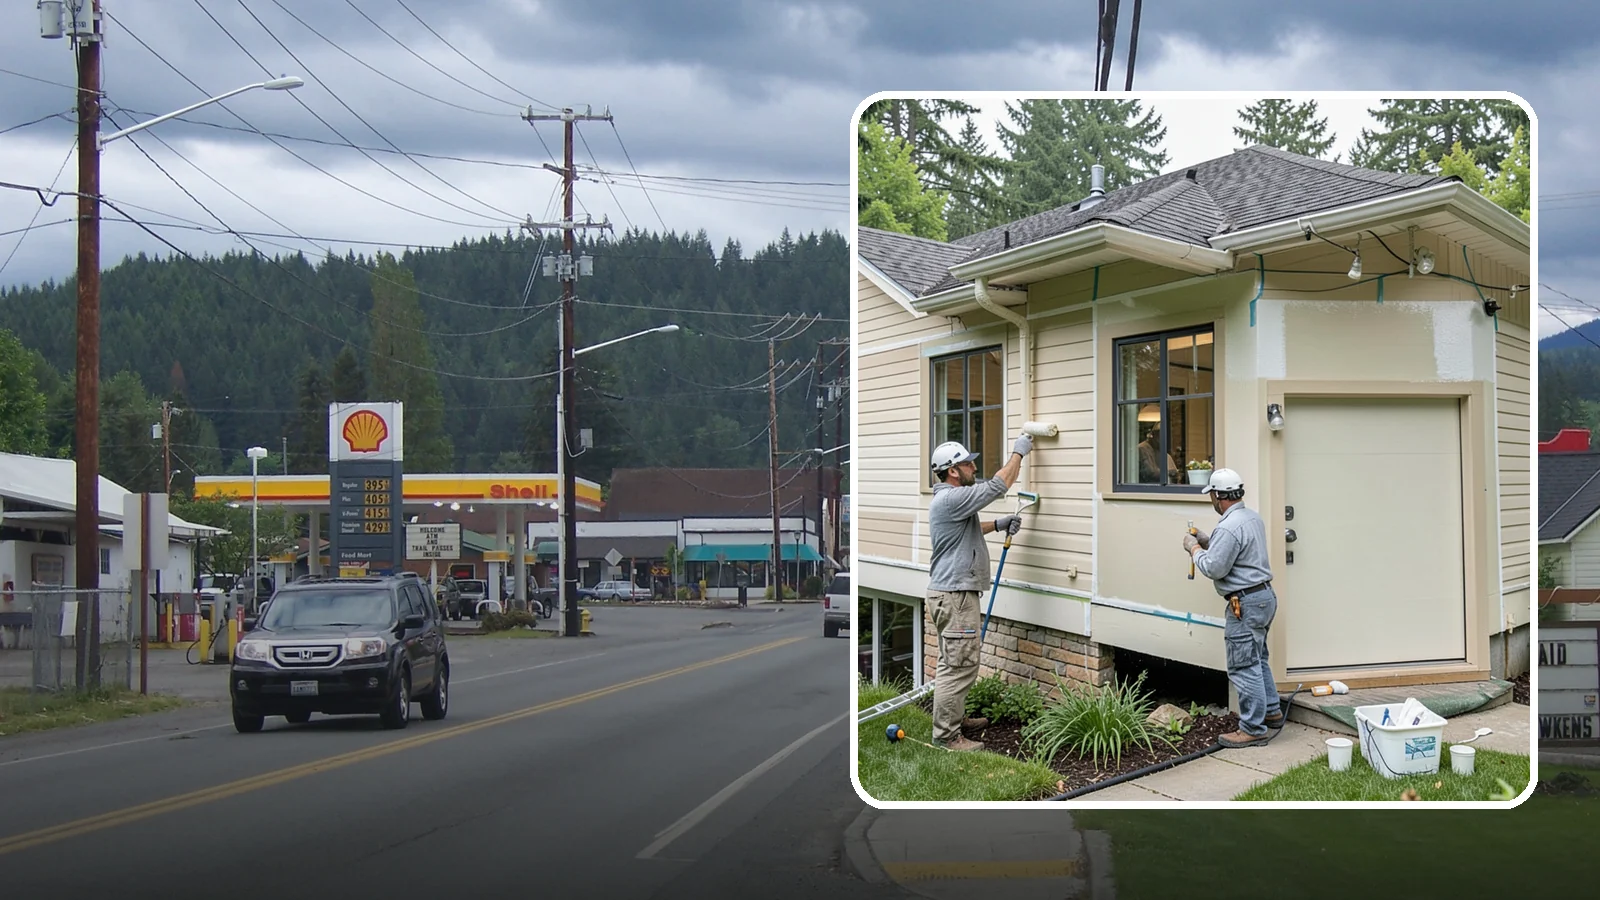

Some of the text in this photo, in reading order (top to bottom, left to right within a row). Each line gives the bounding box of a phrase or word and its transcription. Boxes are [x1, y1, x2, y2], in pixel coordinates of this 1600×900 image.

[366, 480, 383, 490] 395
[490, 484, 547, 499] Shell
[366, 494, 383, 504] 405
[366, 508, 383, 518] 415
[366, 522, 383, 533] 429
[1539, 643, 1566, 665] AID
